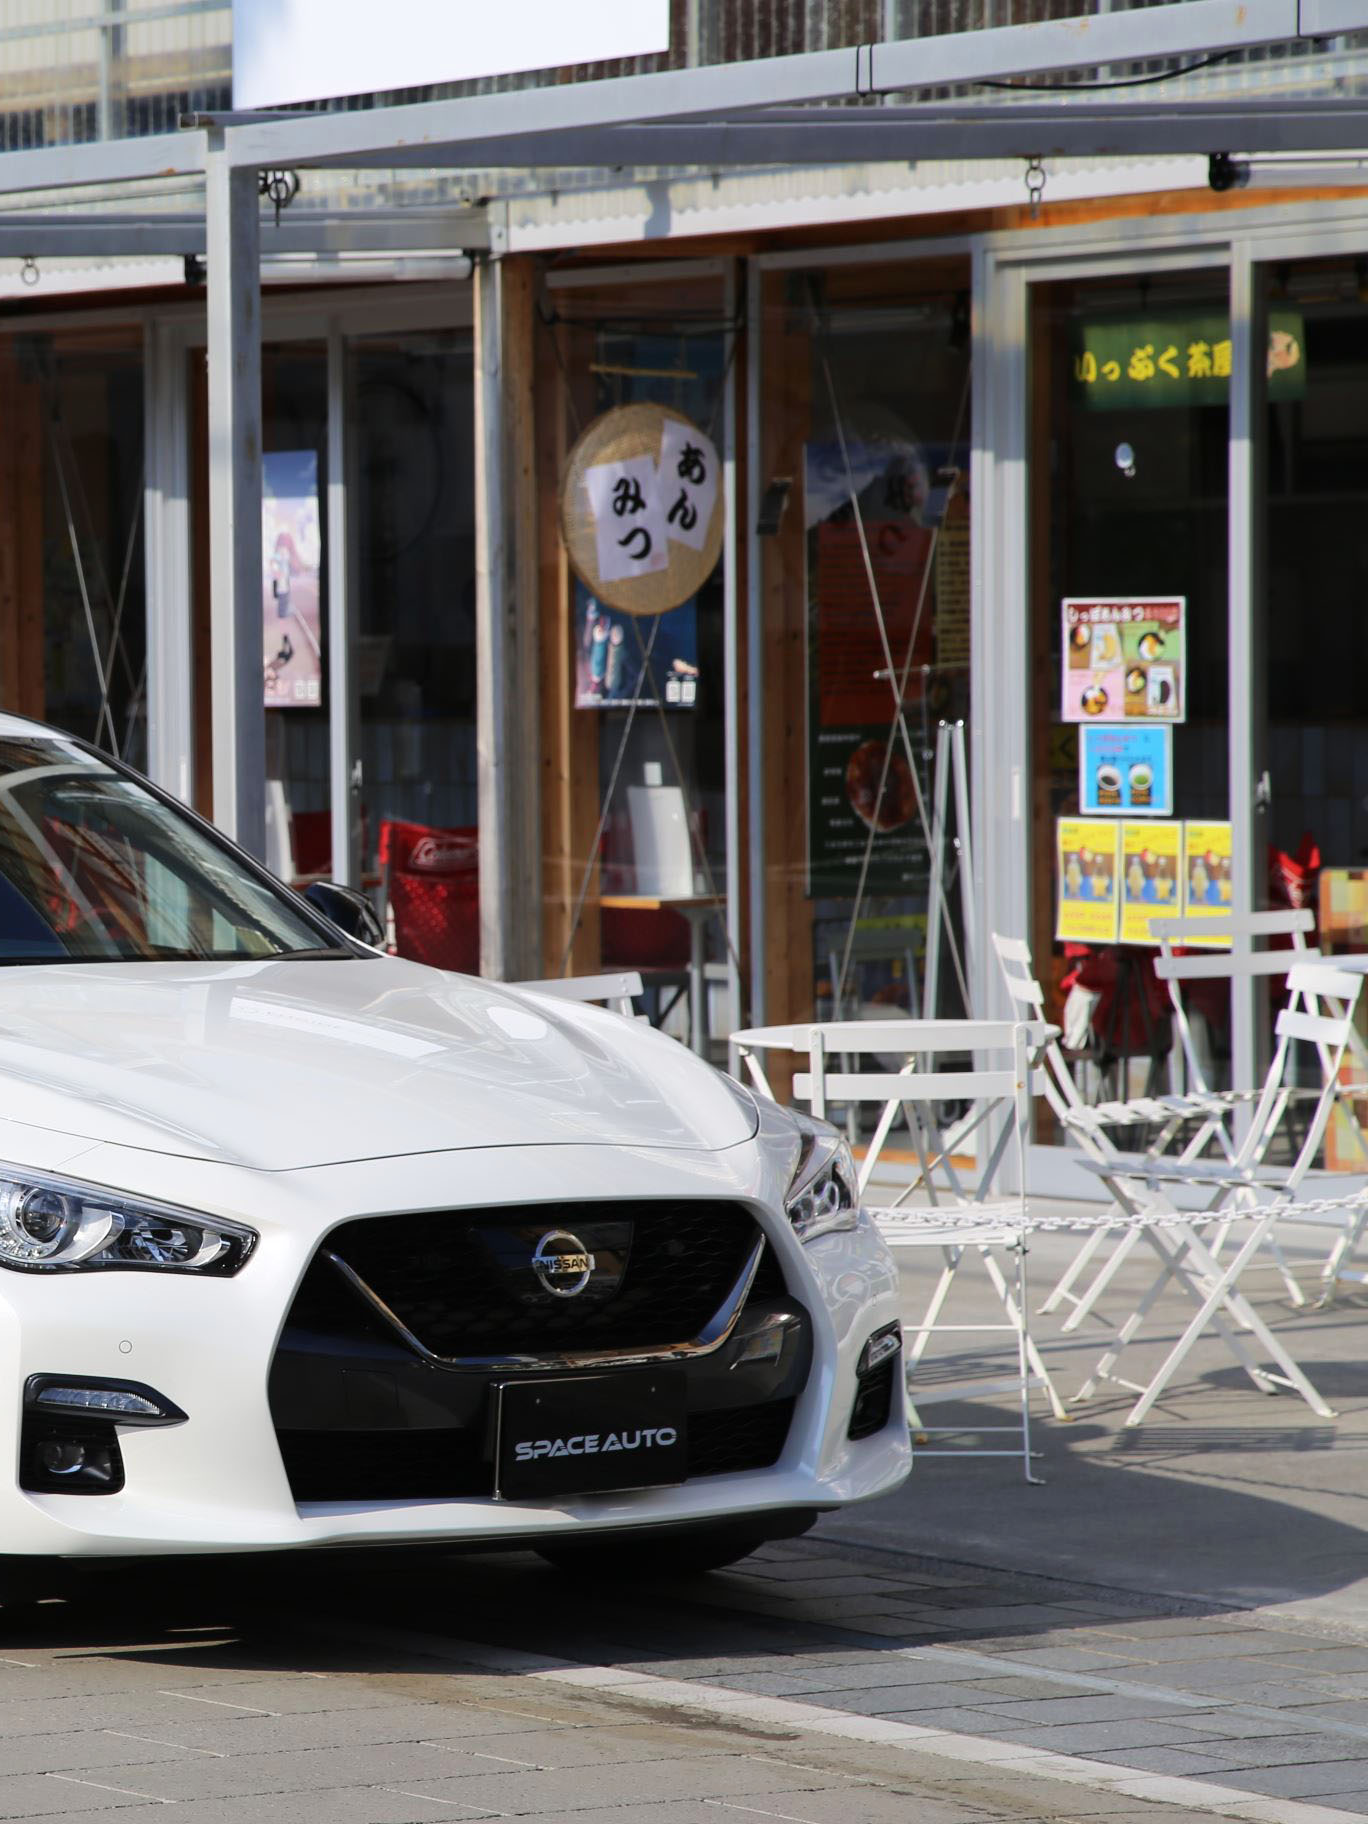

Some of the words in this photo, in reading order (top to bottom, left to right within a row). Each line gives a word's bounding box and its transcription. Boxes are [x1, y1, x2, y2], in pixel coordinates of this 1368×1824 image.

[612, 476, 652, 560] みつ
[667, 440, 706, 531] あん
[540, 1256, 589, 1271] NISSAN
